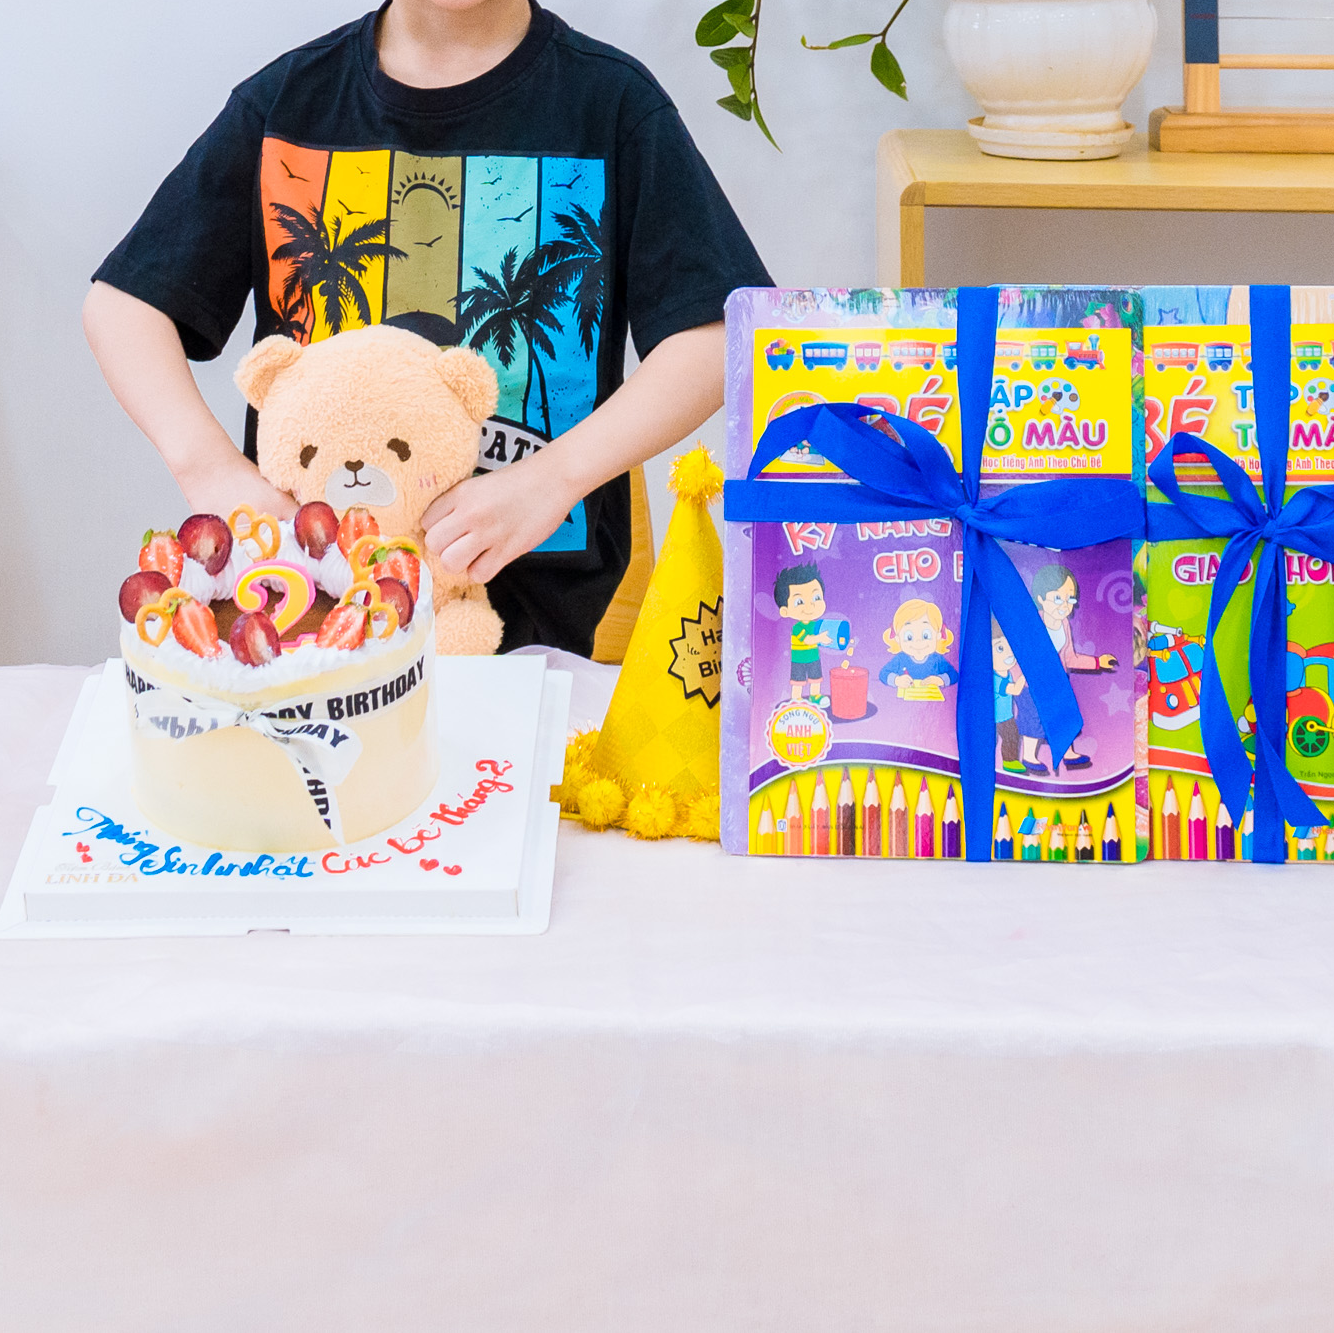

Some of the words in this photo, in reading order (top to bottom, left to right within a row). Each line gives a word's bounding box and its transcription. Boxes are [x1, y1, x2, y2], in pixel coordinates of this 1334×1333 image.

[990, 379, 1034, 413] ẬP
[1025, 415, 1106, 446] MÀU
[1029, 456, 1044, 468] Anh
[1047, 456, 1068, 468] Theo
[1295, 457, 1312, 469] Anh
[875, 550, 940, 581] CHO
[326, 655, 425, 721] BIRTHDAY
[779, 709, 801, 725] SONG
[786, 724, 812, 738] ANH
[786, 741, 812, 759] VIỆT
